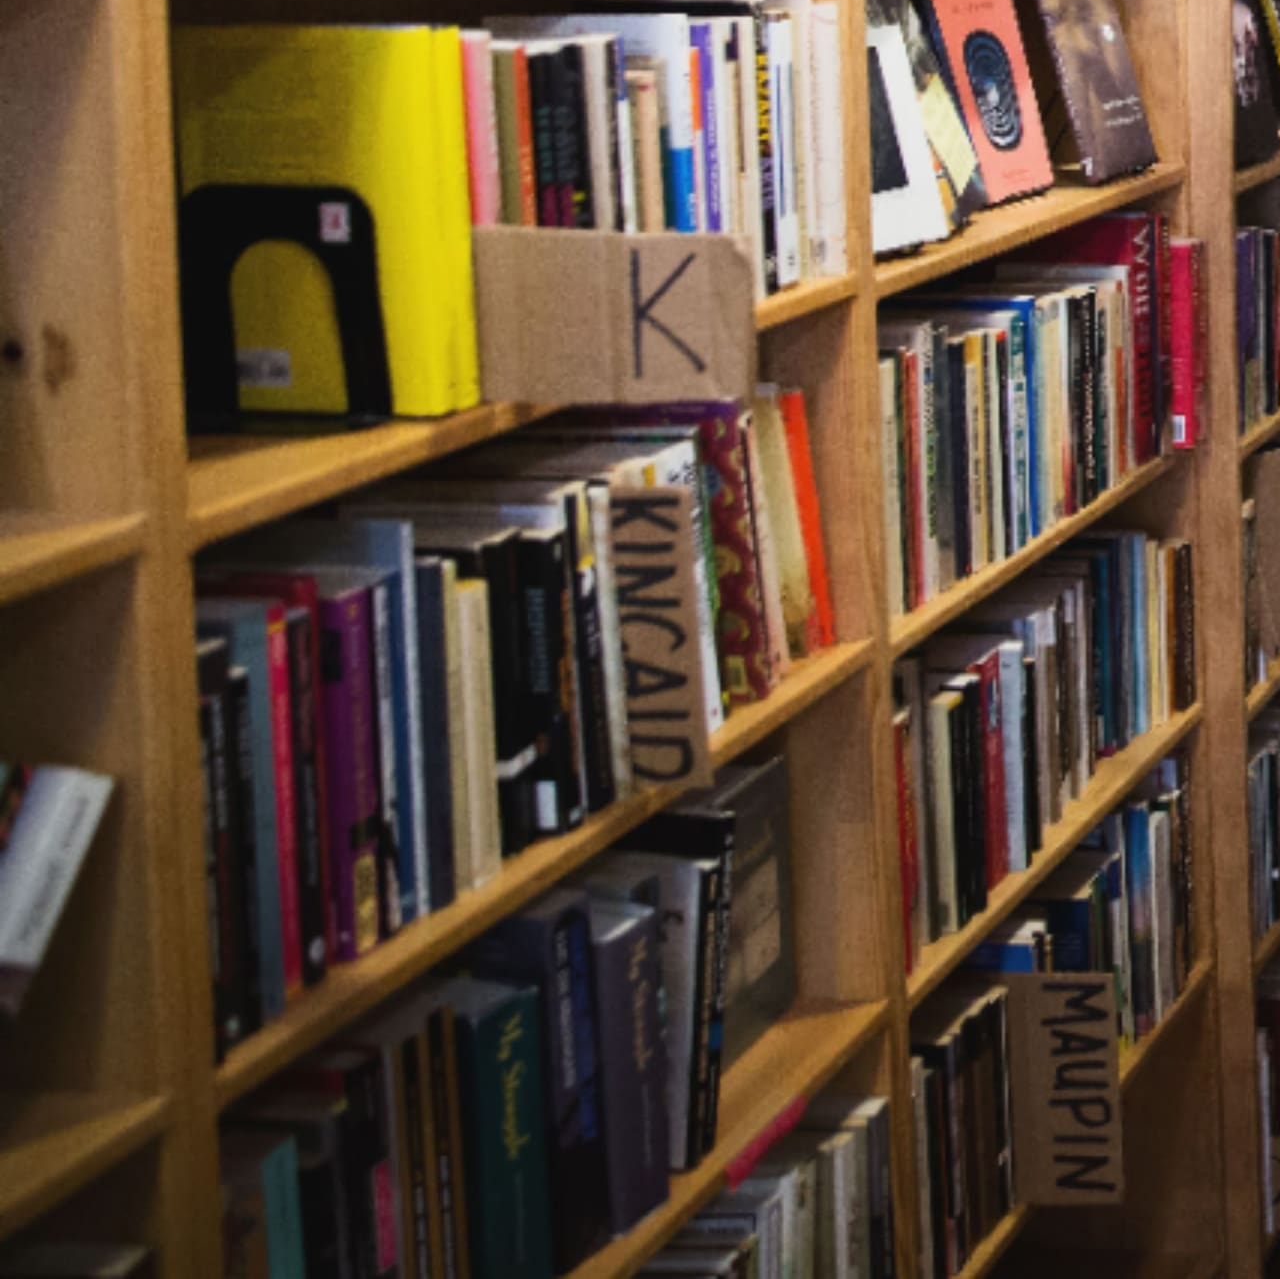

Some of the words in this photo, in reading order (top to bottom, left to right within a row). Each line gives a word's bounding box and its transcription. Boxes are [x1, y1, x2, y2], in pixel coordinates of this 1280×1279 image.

[629, 247, 706, 381] K
[608, 491, 694, 783] KINCAID
[1041, 981, 1118, 1195] MAUPIN
